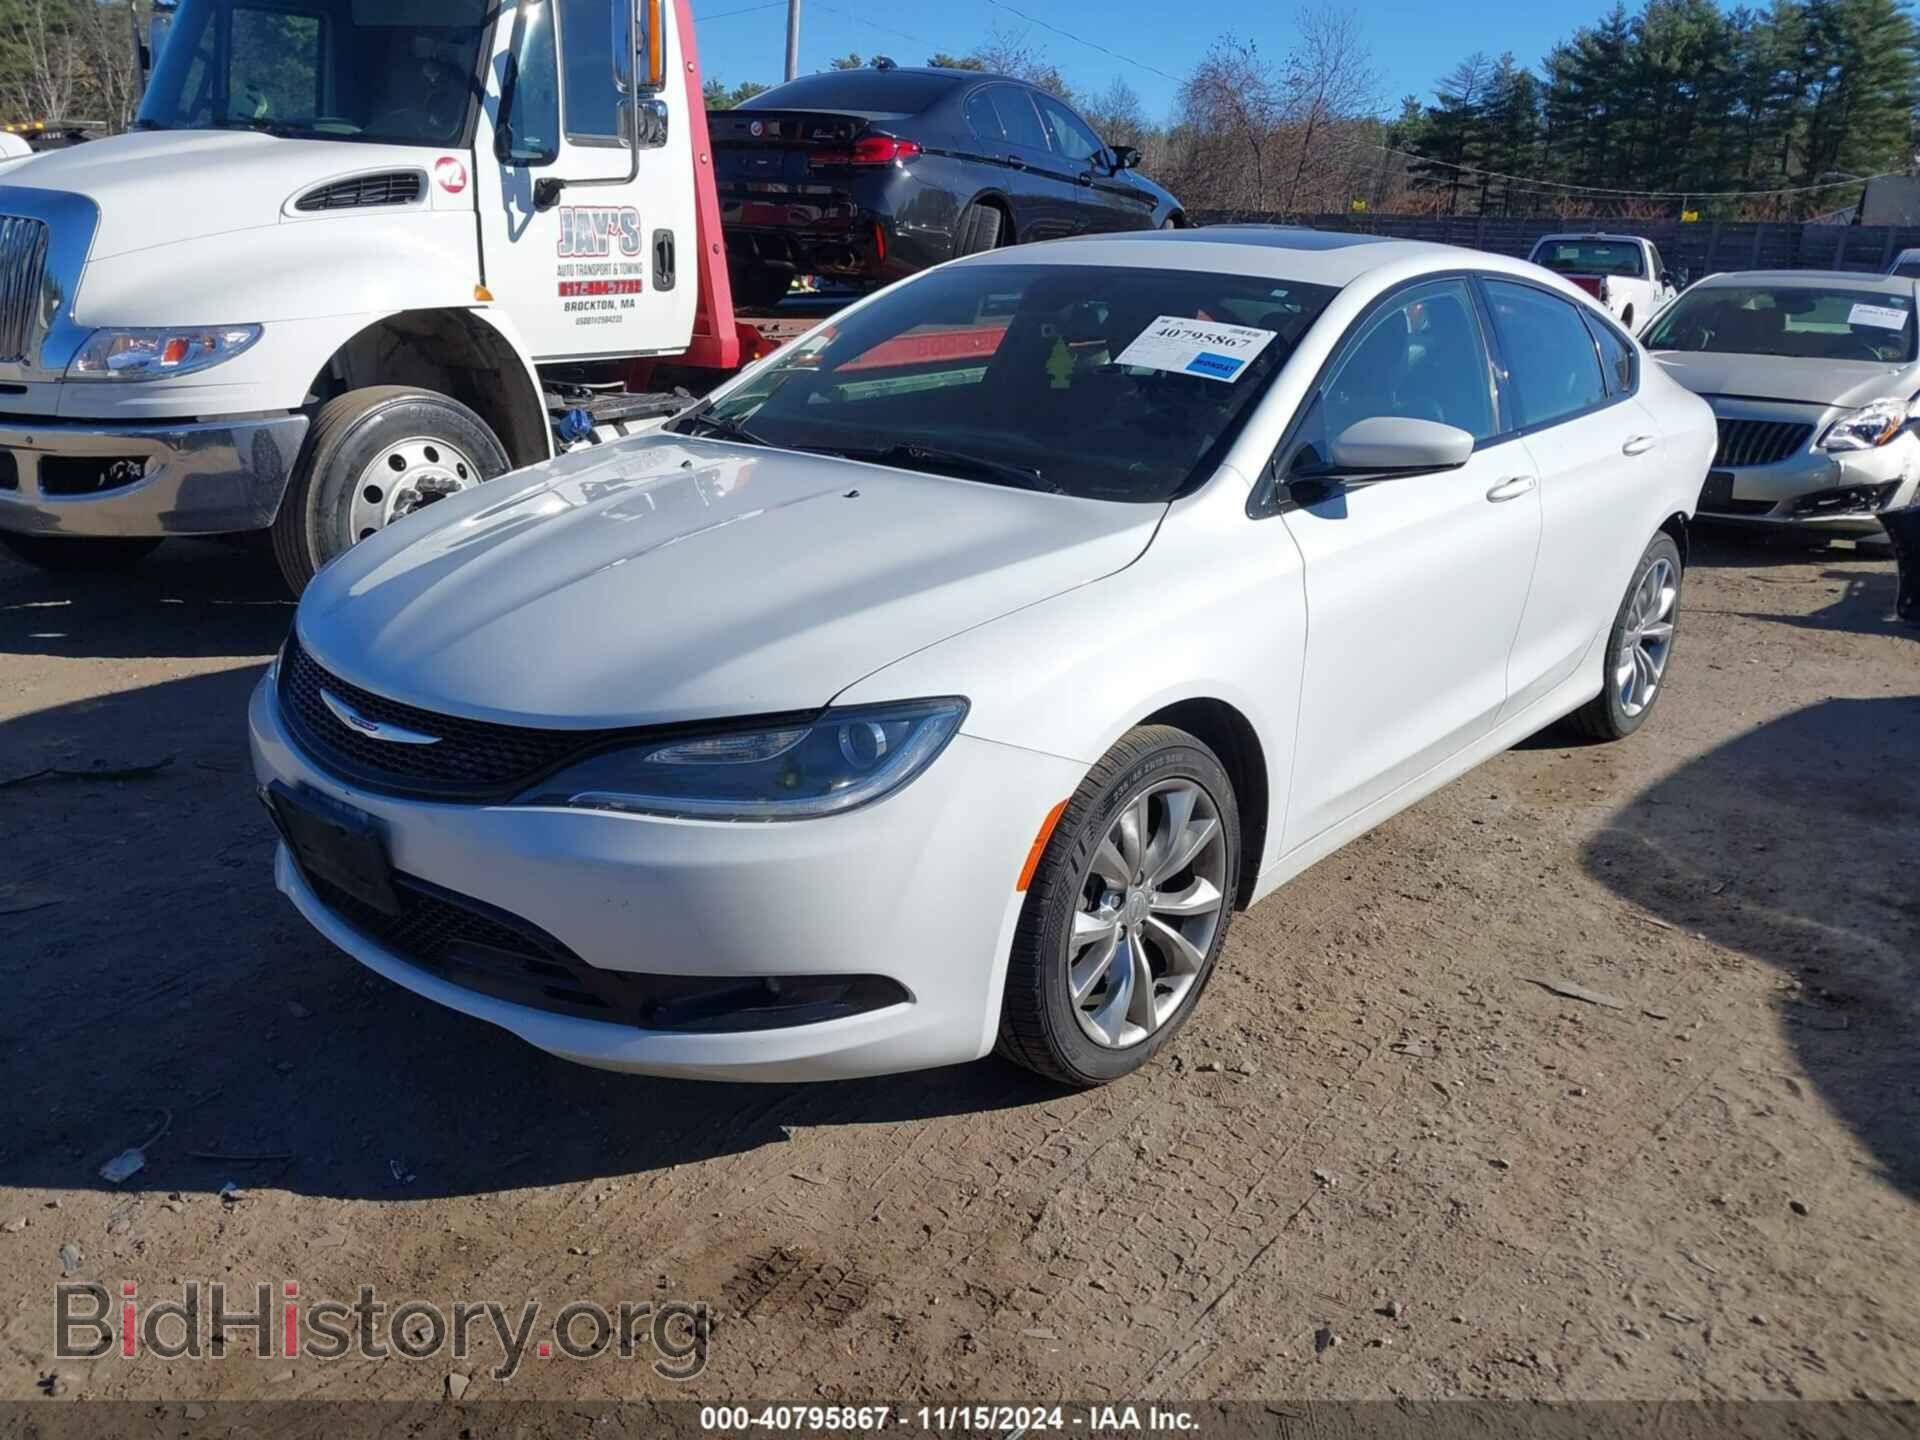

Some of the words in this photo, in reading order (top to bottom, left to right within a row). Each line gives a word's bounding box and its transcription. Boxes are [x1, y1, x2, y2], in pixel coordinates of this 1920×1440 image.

[557, 205, 641, 258] JAY'S
[557, 264, 574, 276] AUTO
[575, 263, 612, 276] TRANSPORT
[619, 262, 643, 274] TOWING
[564, 300, 617, 313] BROCKTON,
[621, 299, 635, 309] MA
[1156, 327, 1251, 348] 40795867
[1194, 357, 1236, 374] MONDAY
